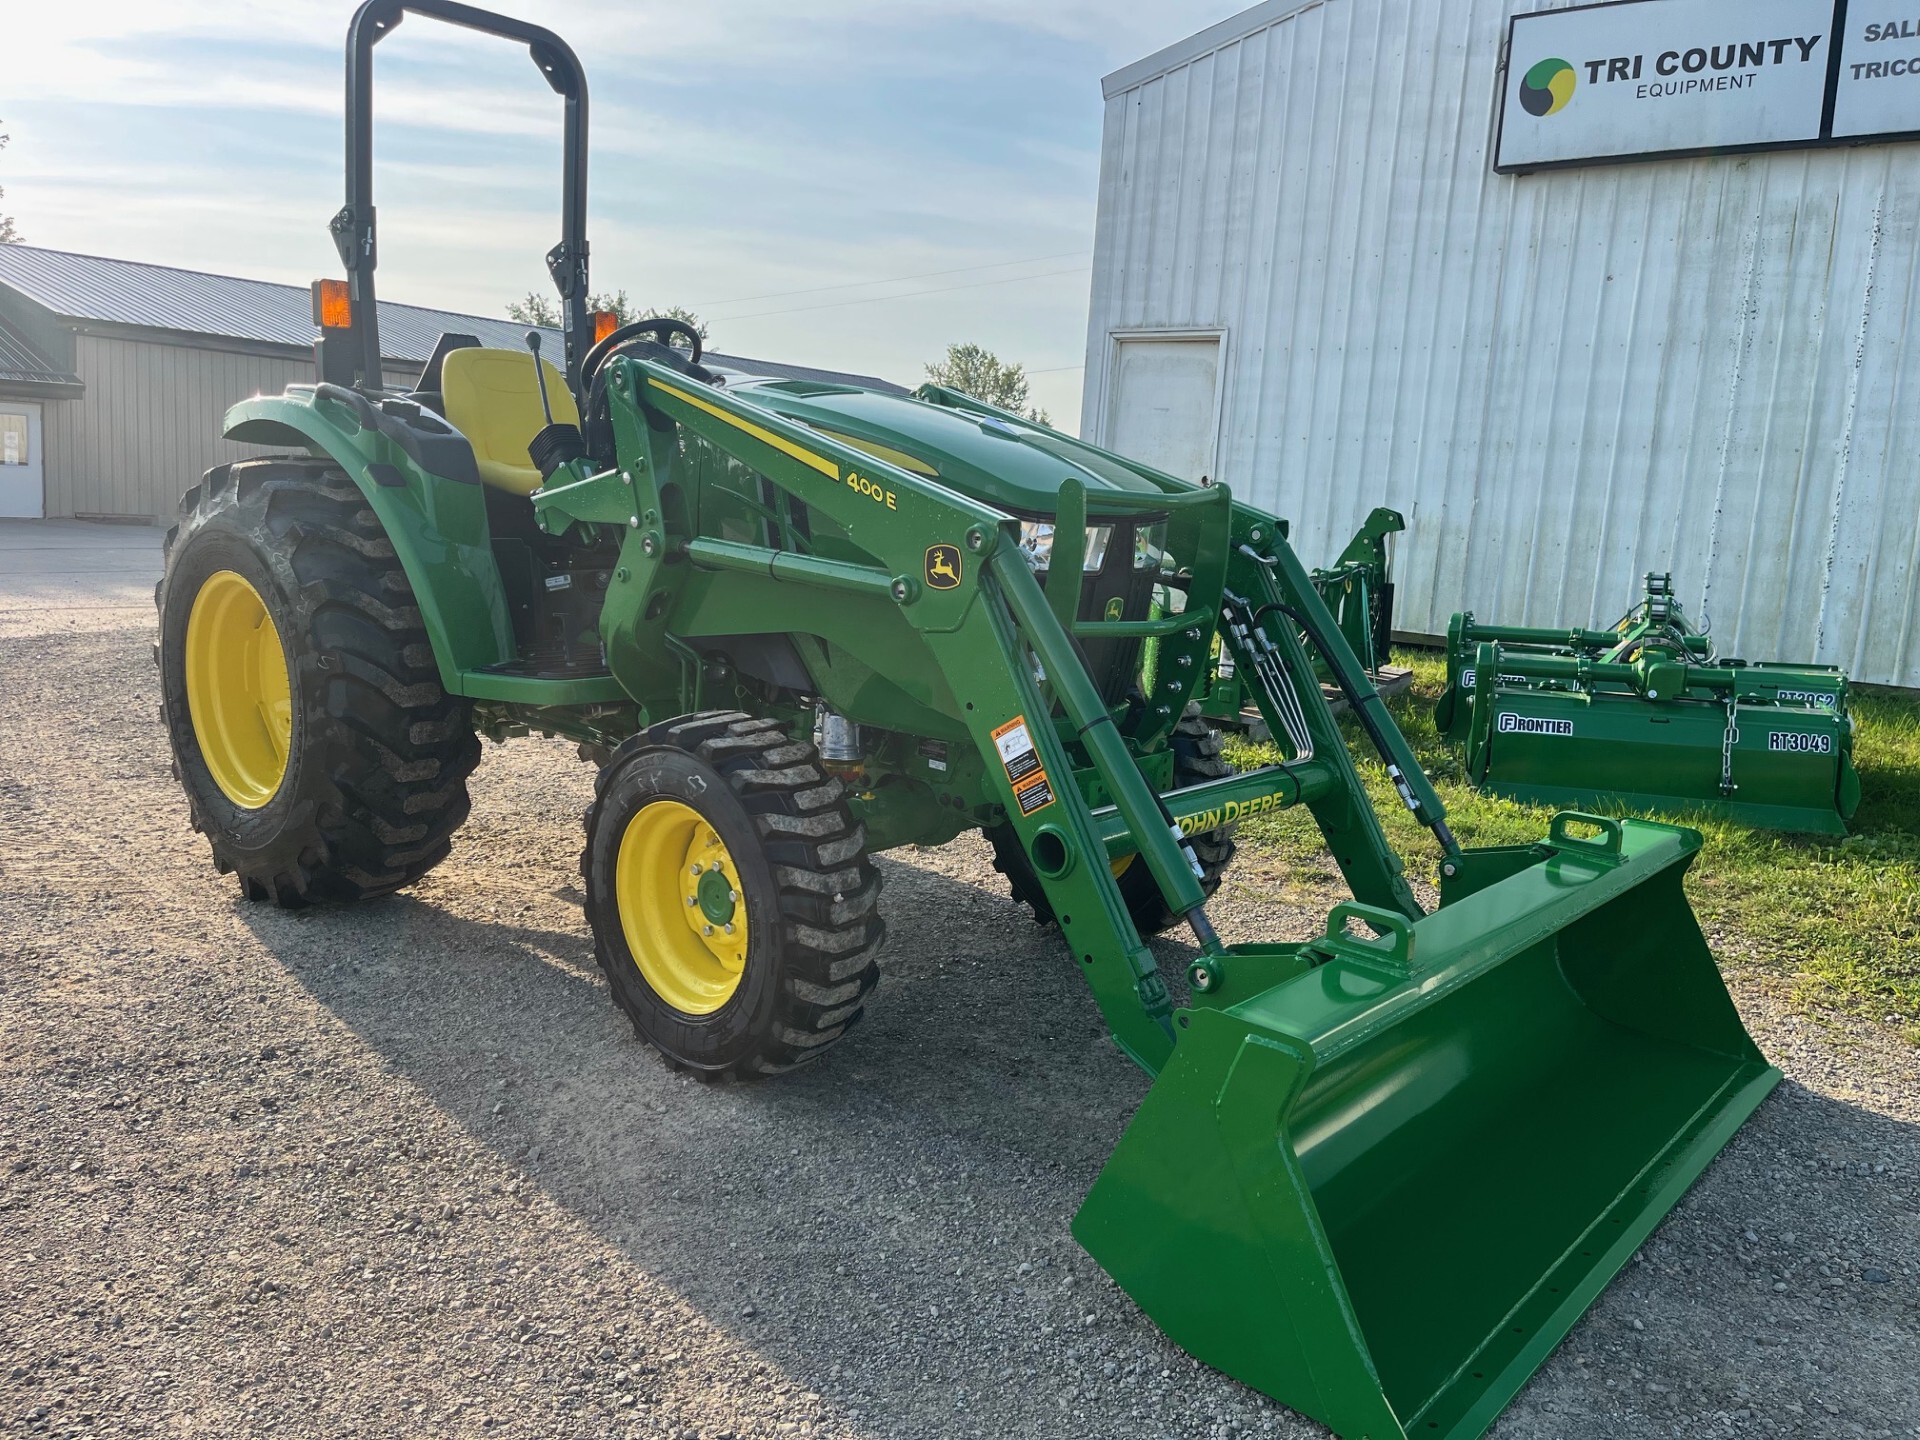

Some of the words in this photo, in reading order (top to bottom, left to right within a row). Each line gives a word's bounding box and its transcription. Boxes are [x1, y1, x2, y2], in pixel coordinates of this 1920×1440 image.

[1864, 19, 1920, 42] SAL
[1584, 55, 1643, 85] TRI
[1655, 35, 1822, 77] COUNTY
[1636, 73, 1757, 99] EQUIPMENT
[1500, 714, 1572, 735] FRONTIER
[1769, 732, 1830, 753] RT3049
[1224, 792, 1284, 825] DEERE
